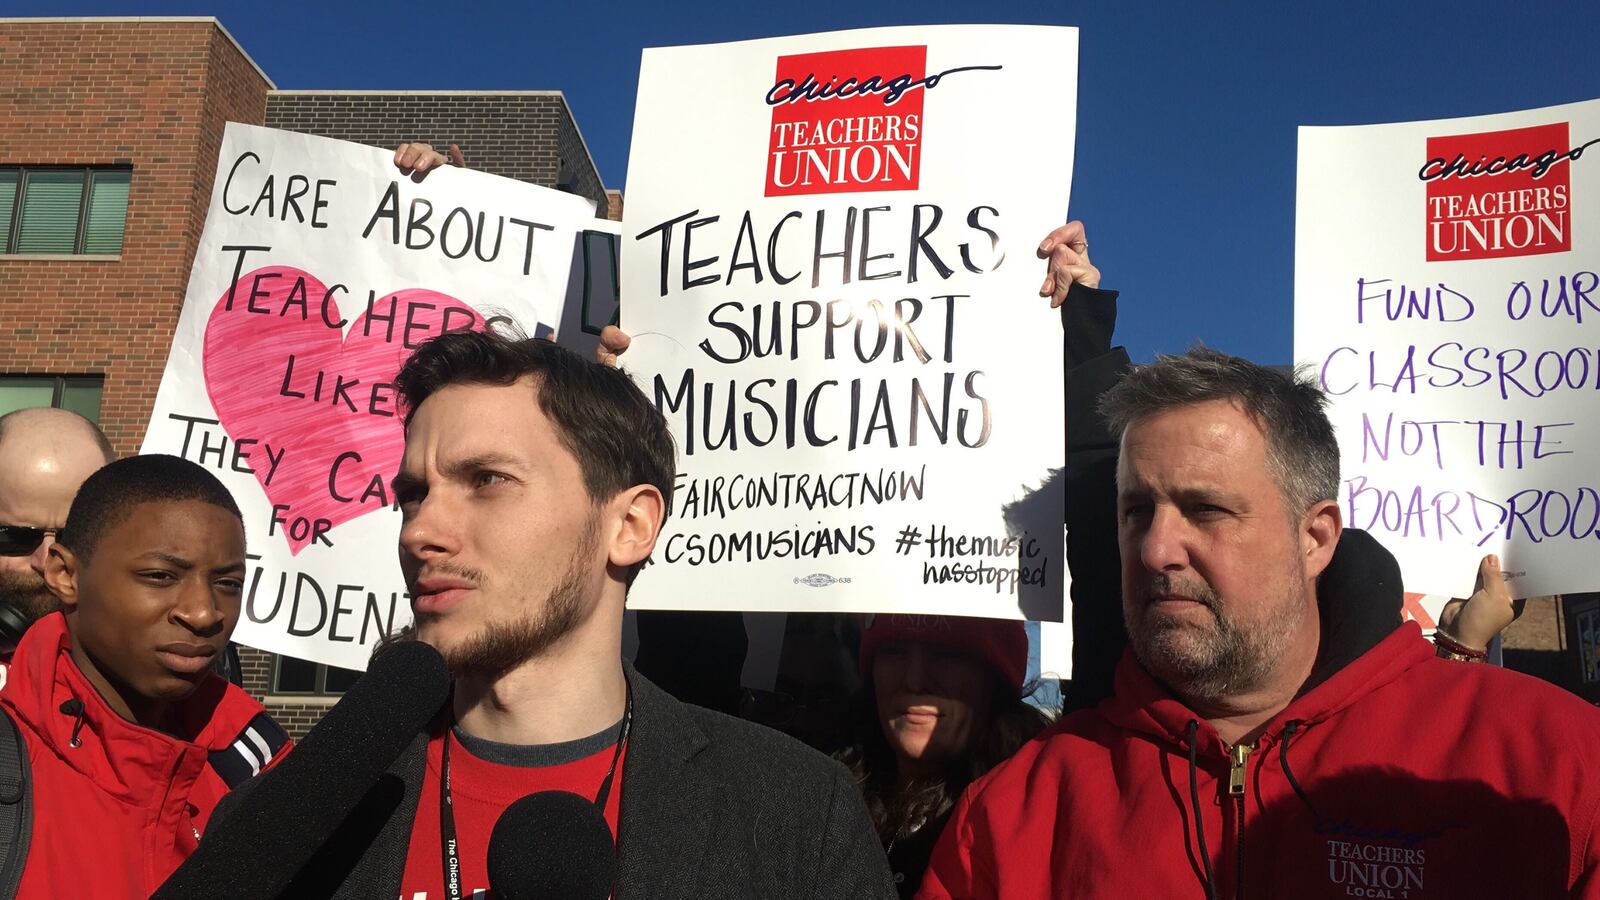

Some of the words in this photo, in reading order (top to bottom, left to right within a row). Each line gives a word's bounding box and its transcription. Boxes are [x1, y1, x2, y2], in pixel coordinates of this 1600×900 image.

[765, 66, 1002, 107] Chicago
[773, 113, 919, 148] TEACHERS
[772, 143, 918, 188] UNION
[1418, 139, 1600, 181] Chicago
[223, 151, 337, 228] CARE
[362, 181, 555, 275] ABOUT
[1429, 184, 1567, 219] TEACHERS
[635, 204, 1005, 297] TEACHERS
[1430, 210, 1567, 254] UNION
[1357, 277, 1475, 324] FUND
[1507, 271, 1600, 324] OUR
[699, 295, 971, 364] SUPPORT
[280, 355, 398, 417] LIKE
[1321, 342, 1600, 400] CLASSROO
[653, 368, 991, 456] MUSICIANS
[169, 413, 285, 486] THEY
[1362, 412, 1460, 469] NOT
[1464, 420, 1574, 469] THE
[329, 451, 400, 511] CA
[269, 504, 334, 547] FOR
[1344, 475, 1600, 547] BOARDROO
[895, 524, 1041, 558] #themusic
[245, 554, 411, 645] UDEN
[448, 838, 457, 856] The
[1327, 840, 1425, 865] TEACHERS
[449, 857, 459, 895] Chicago
[1327, 858, 1425, 890] UNION
[1346, 885, 1395, 899] LOCAL
